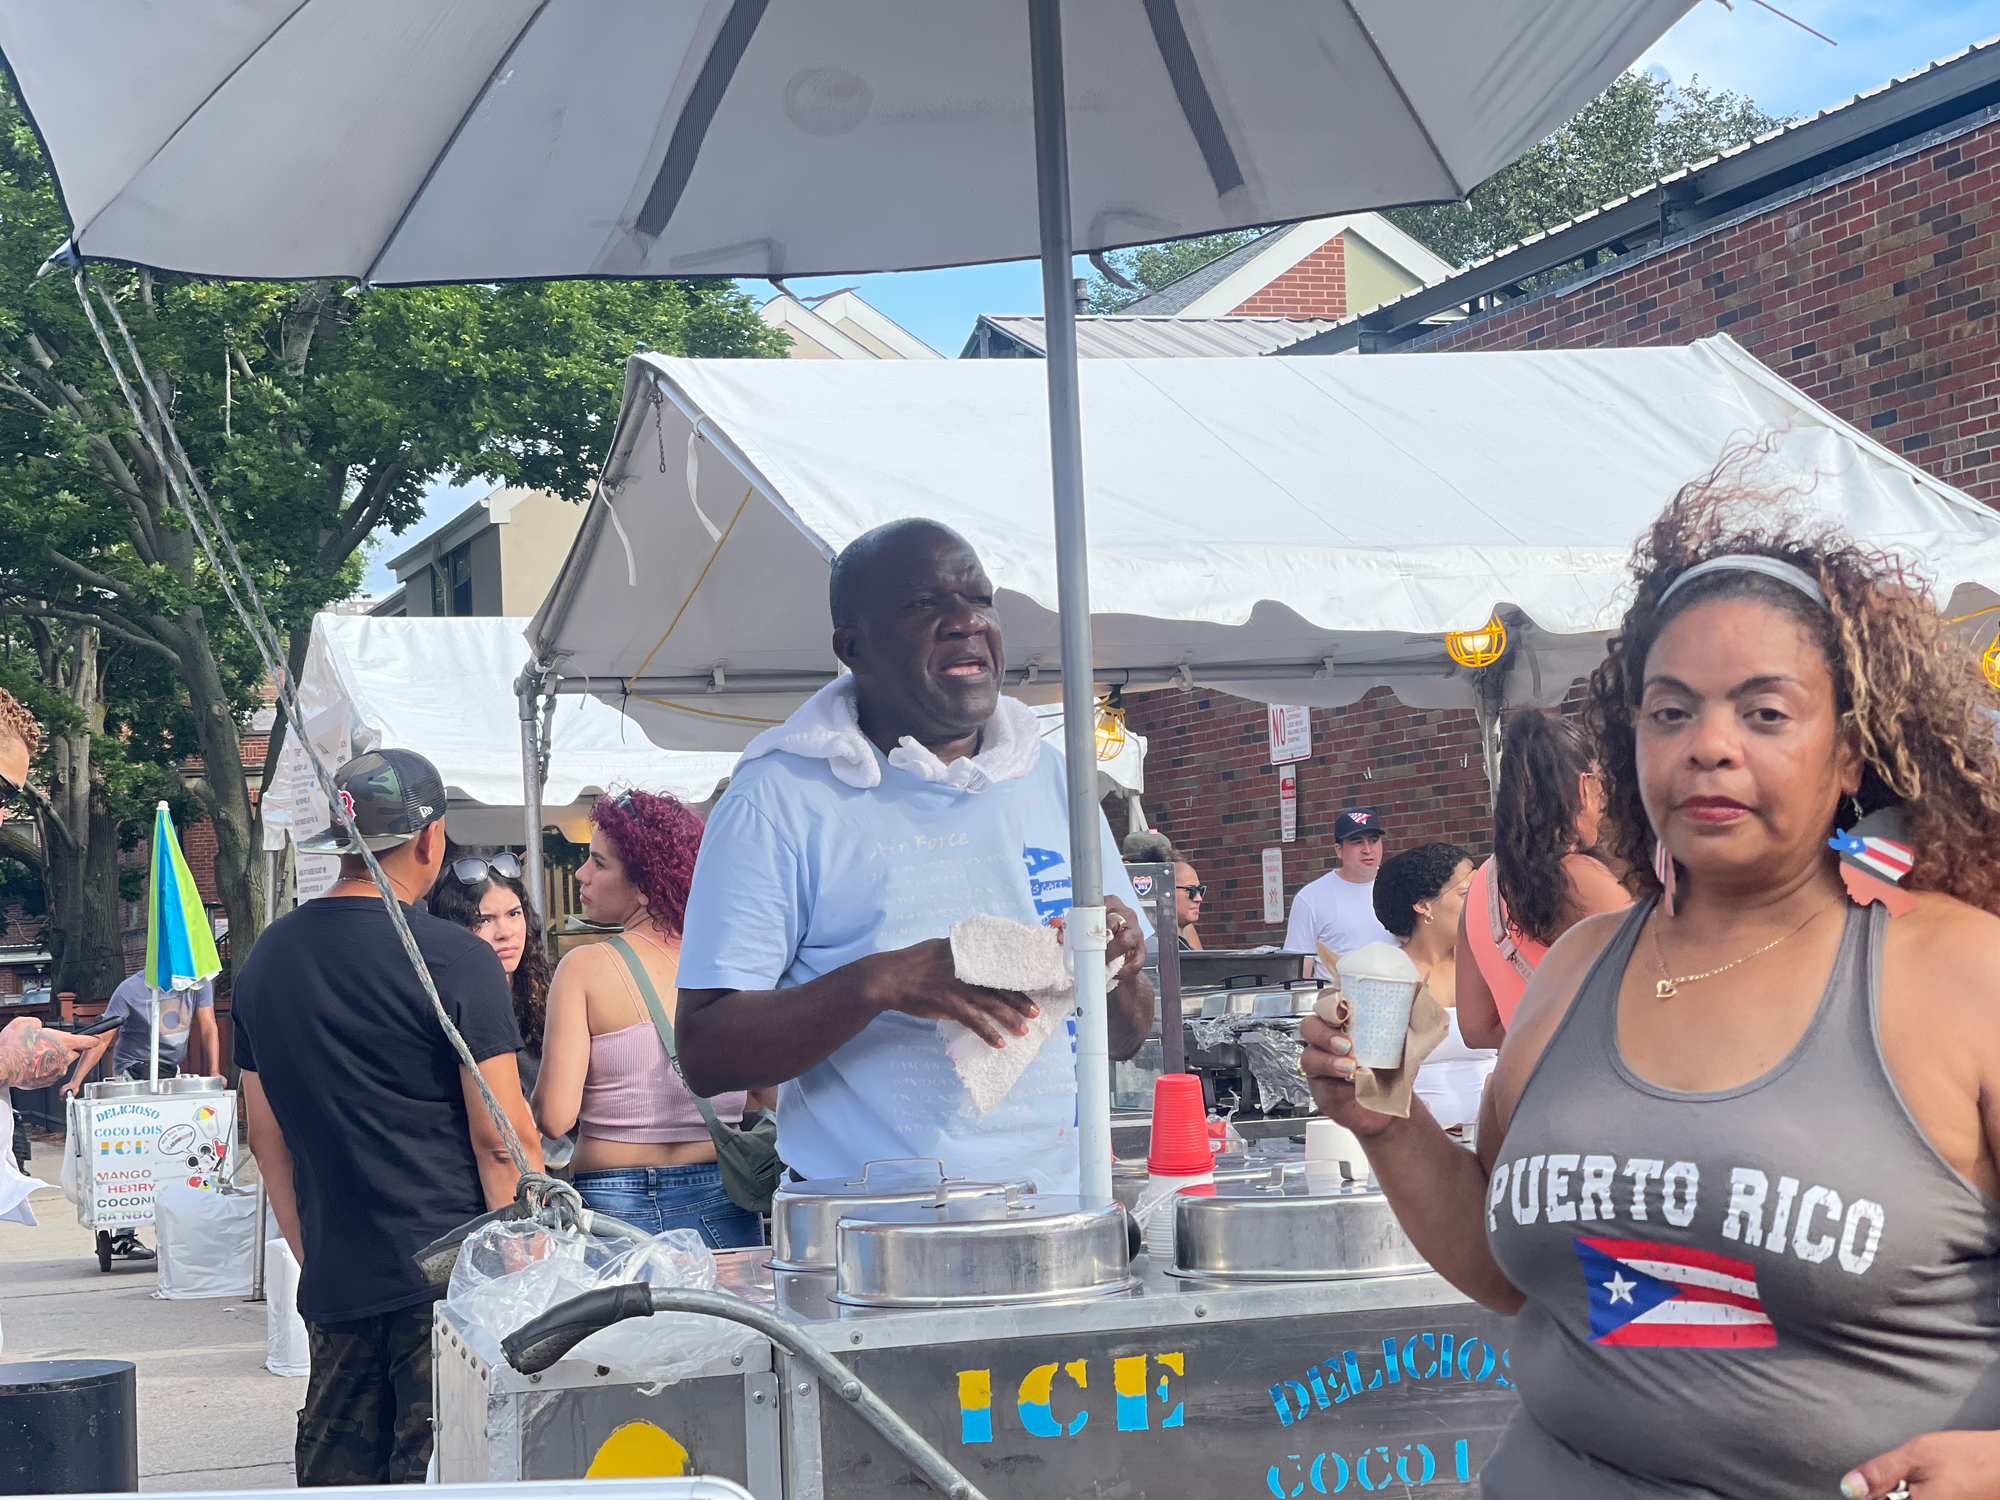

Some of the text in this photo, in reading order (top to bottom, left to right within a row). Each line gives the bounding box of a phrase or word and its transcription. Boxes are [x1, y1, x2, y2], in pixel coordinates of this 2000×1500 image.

[1272, 707, 1286, 748] NO
[912, 831, 970, 853] Force
[96, 1104, 160, 1122] DELICIOSO
[94, 1125, 163, 1138] COCO LOIS
[101, 1140, 150, 1155] ICE
[97, 1169, 152, 1181] MANGO
[1488, 1154, 1885, 1275] PUERTO RICO
[956, 1352, 1184, 1444] ICE
[1266, 1442, 1436, 1500] COCO
